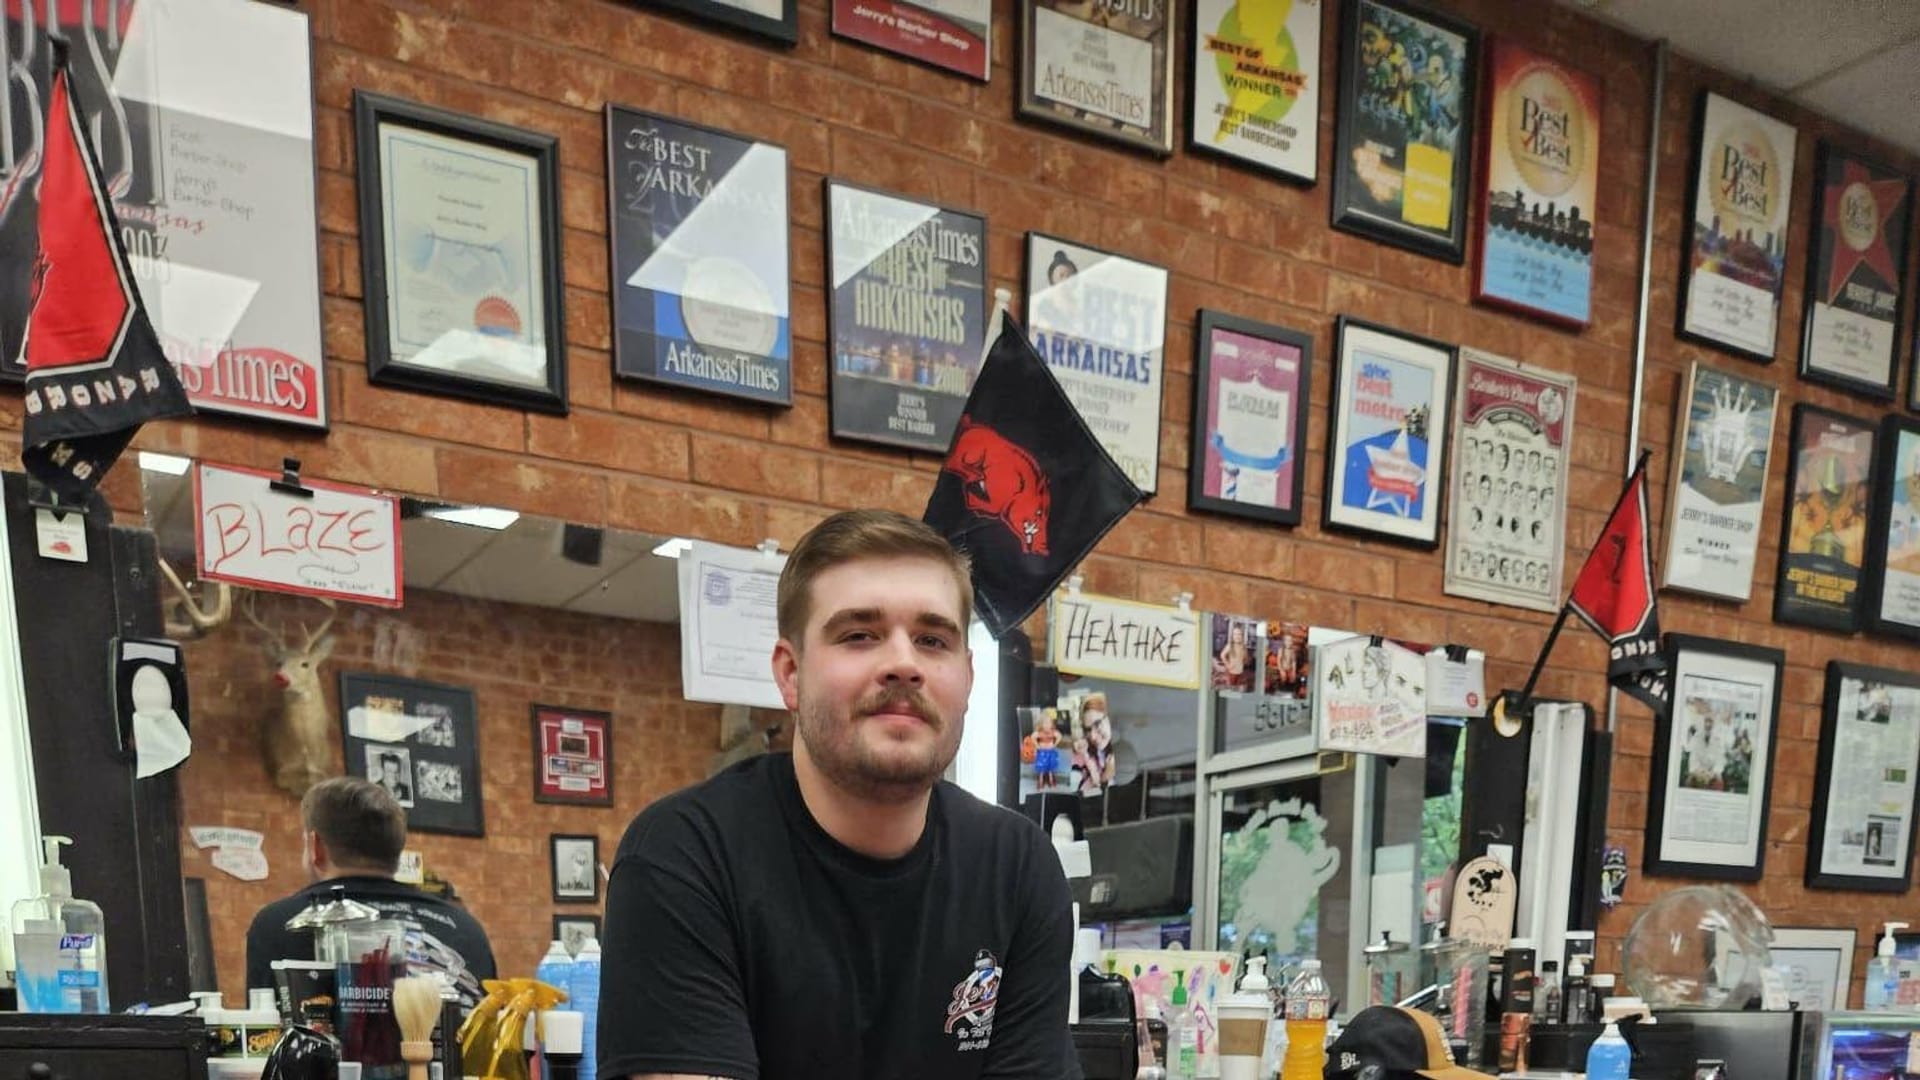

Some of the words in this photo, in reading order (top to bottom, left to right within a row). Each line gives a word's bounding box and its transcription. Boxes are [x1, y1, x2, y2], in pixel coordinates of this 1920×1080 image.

[1209, 38, 1242, 55] BEST
[1244, 46, 1263, 59] OF
[1224, 73, 1283, 98] WINNER
[1236, 61, 1306, 86] ARKANSAS
[1520, 95, 1569, 138] Best
[653, 137, 711, 171] BEST
[854, 277, 965, 346] ARKANSAS
[1065, 603, 1184, 664] HEATHRE
